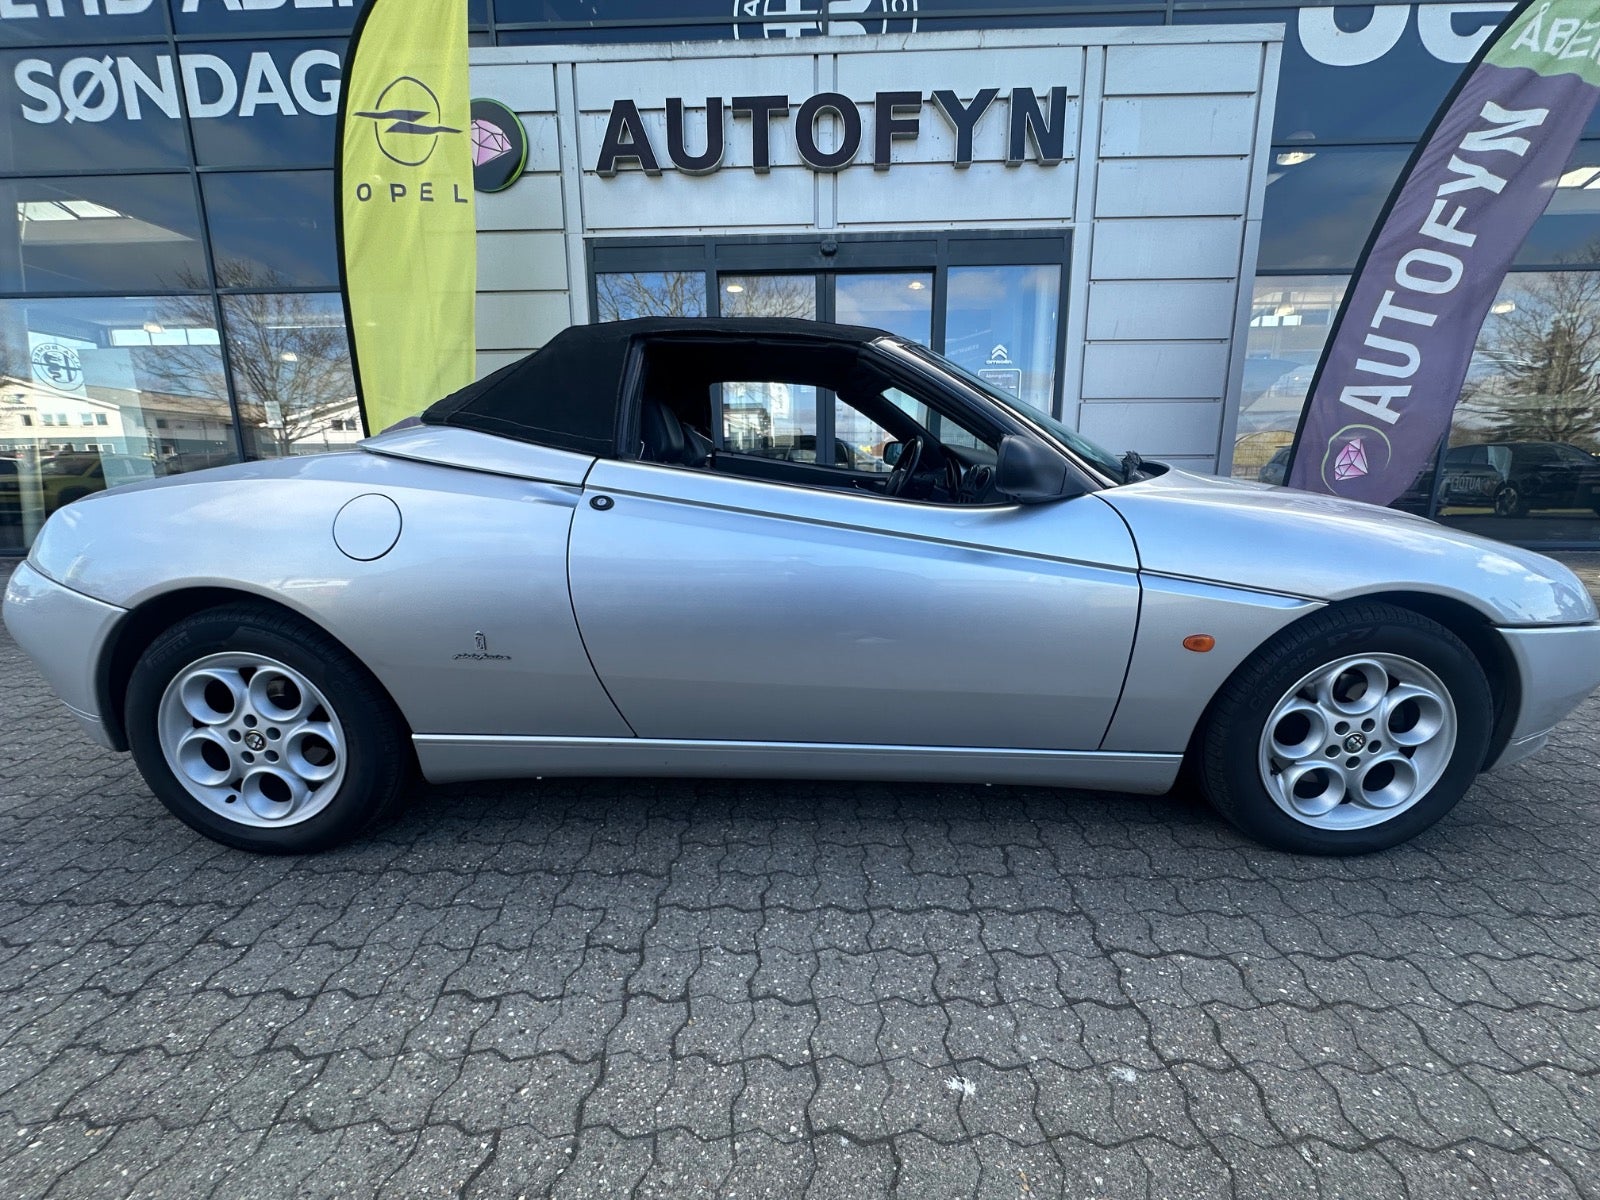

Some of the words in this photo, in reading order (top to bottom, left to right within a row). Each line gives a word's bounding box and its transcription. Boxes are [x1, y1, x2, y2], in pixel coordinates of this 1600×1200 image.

[14, 49, 341, 125] SØNDAG
[595, 86, 1068, 178] AUTOFYN
[356, 182, 468, 204] OPEL
[1339, 100, 1550, 424] AUTOFYN
